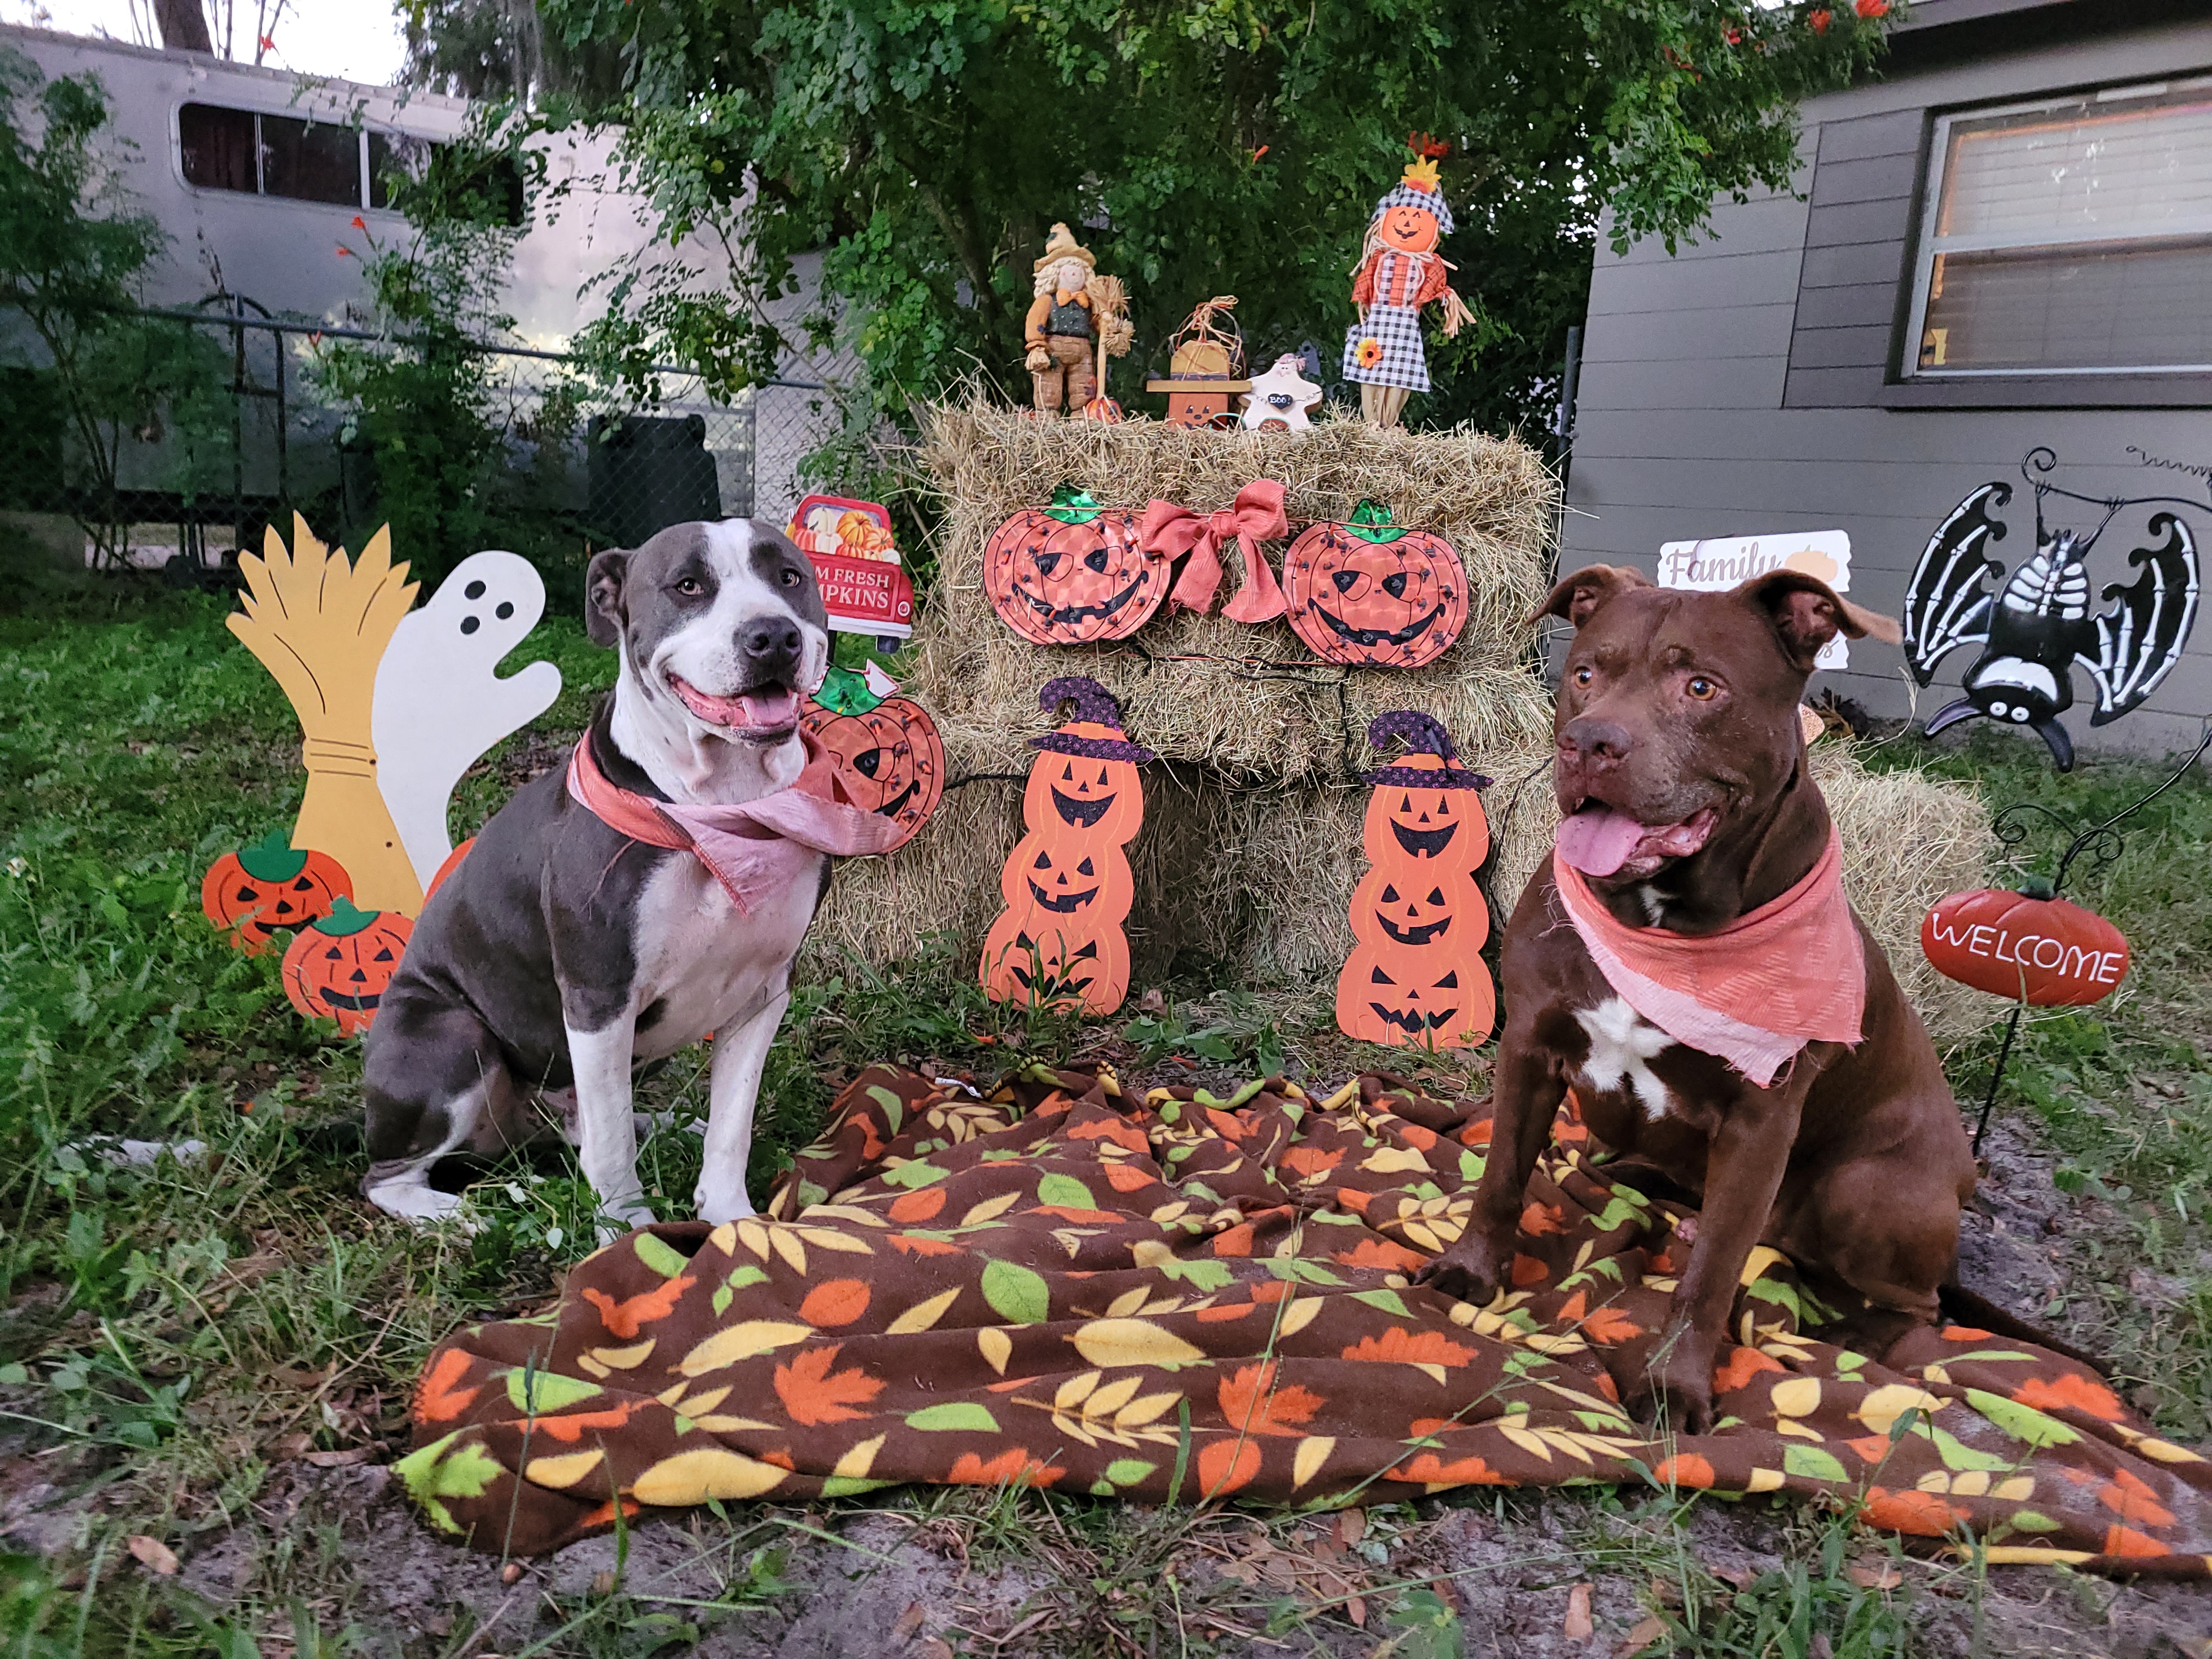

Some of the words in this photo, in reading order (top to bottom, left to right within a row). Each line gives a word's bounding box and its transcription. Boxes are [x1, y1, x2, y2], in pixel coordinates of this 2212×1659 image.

[1269, 396, 1291, 405] BOO!
[833, 568, 889, 588] FRESH
[818, 583, 889, 609] PKINS
[1932, 912, 2124, 984] WELCOME
